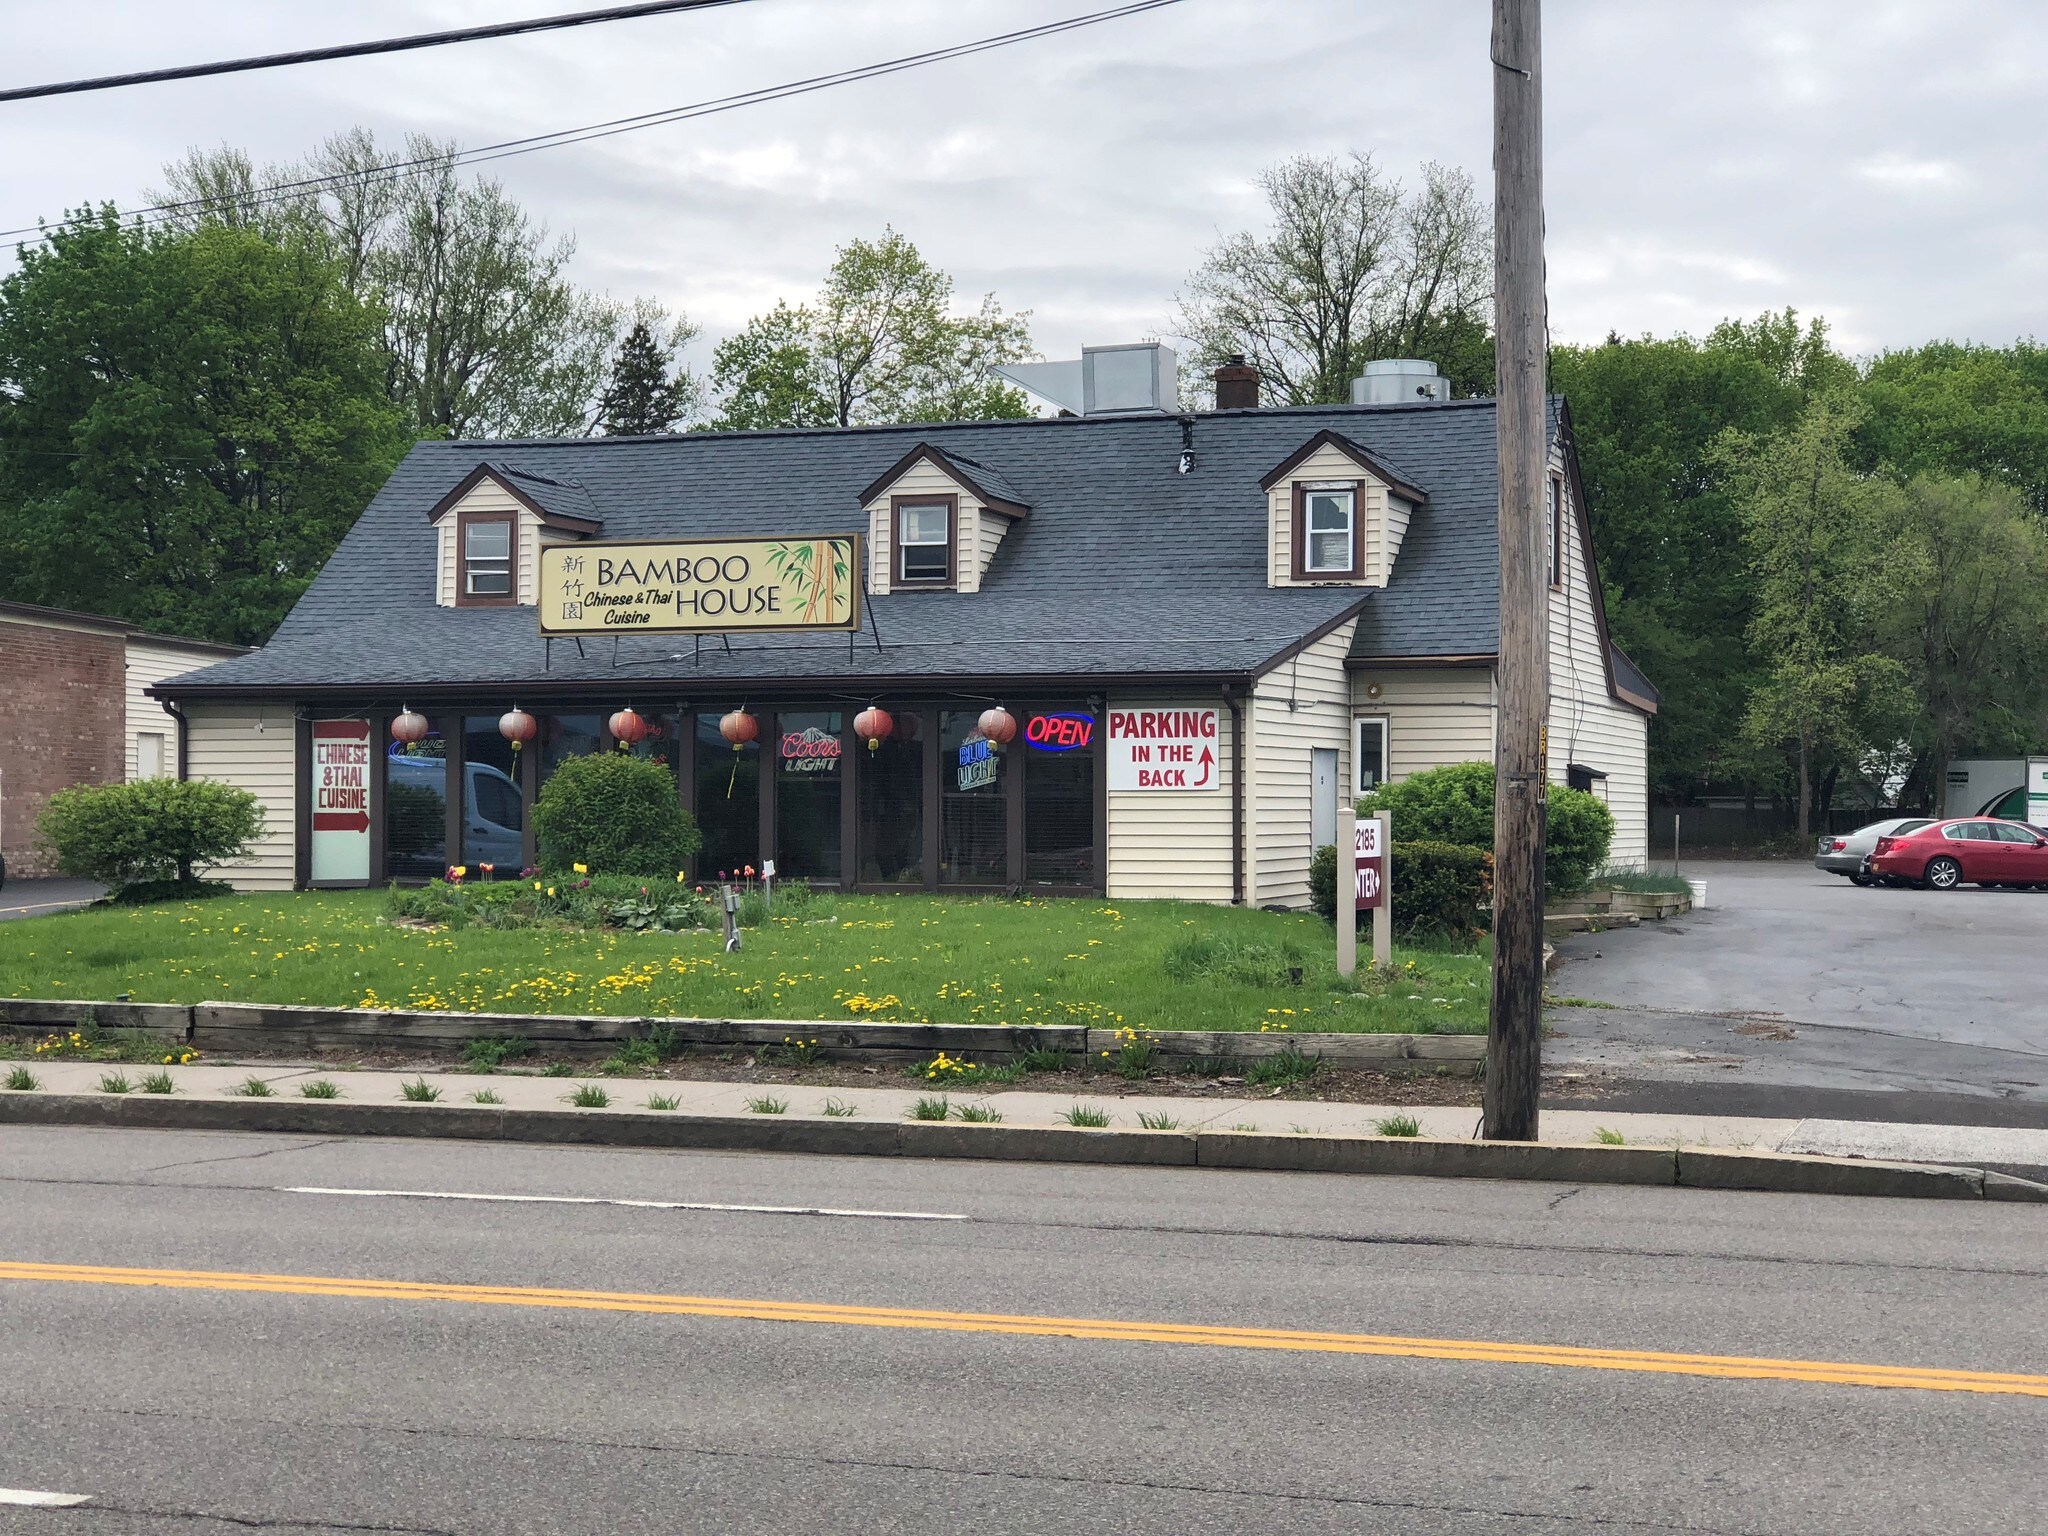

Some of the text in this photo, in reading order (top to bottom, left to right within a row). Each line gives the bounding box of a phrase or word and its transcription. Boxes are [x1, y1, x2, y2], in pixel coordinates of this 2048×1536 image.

[597, 555, 750, 586] BAMBOO
[560, 554, 586, 621] 新竹園
[584, 590, 633, 607] Chinese
[644, 589, 673, 605] Thai
[676, 584, 781, 616] HOUSE
[604, 608, 651, 625] Cuisine
[1027, 715, 1092, 748] OPEN
[1109, 711, 1216, 739] PARKING
[317, 743, 369, 765] CHINESE
[782, 732, 842, 758] Coors
[1131, 745, 1194, 763] IN THE
[784, 757, 840, 772] LIGHT
[957, 756, 1000, 787] LIGHT
[1138, 768, 1186, 787] BACK
[318, 787, 368, 809] CUISINE
[1355, 828, 1375, 850] 2185
